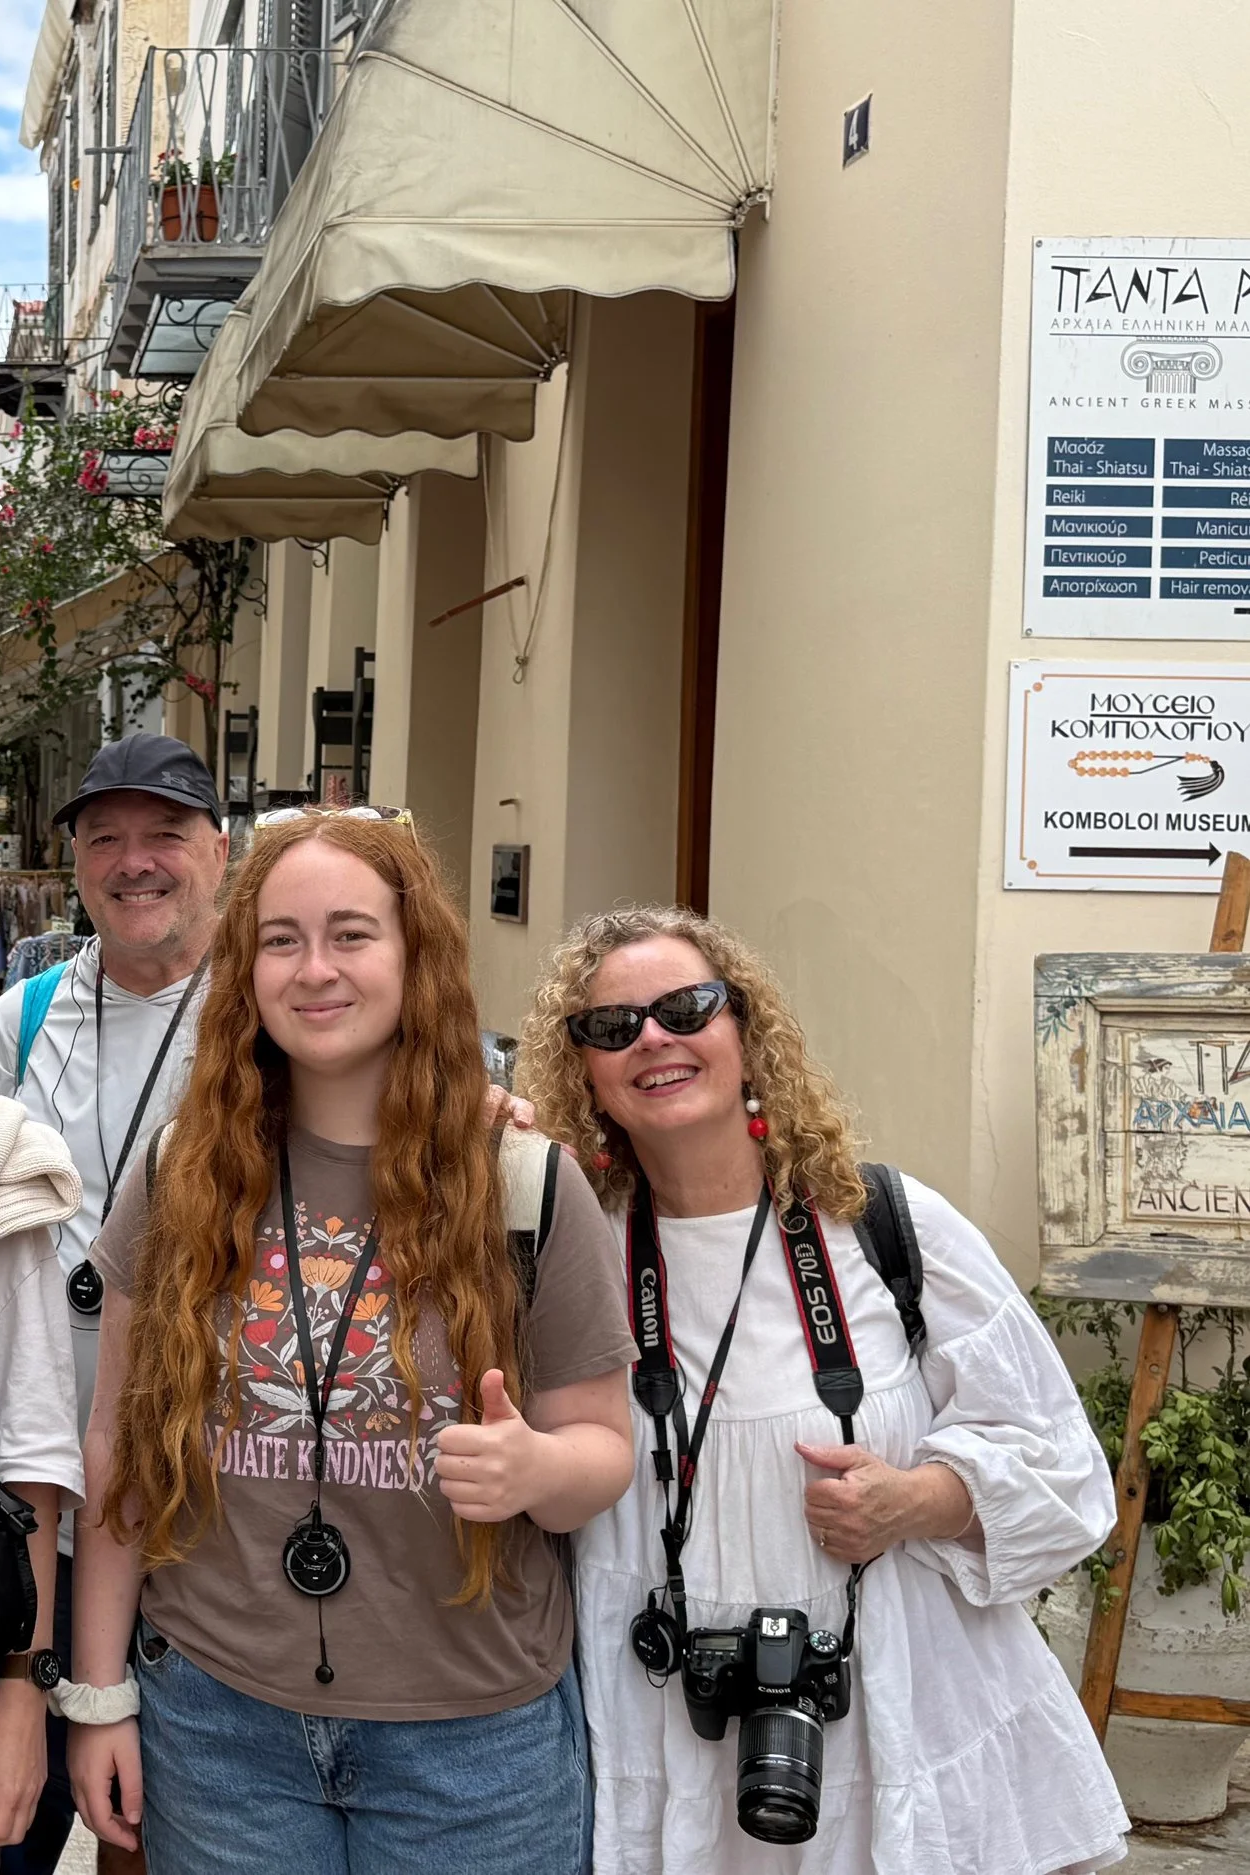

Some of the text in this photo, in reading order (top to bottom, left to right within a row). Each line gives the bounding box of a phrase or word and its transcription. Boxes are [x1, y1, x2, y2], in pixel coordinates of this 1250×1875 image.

[1050, 265, 1209, 314] ΠΑΝΤΑ
[1049, 396, 1129, 408] ANCIENT
[1140, 398, 1197, 409] GREEK
[1053, 460, 1083, 474] Thai
[1096, 460, 1147, 475] Shiatsu
[1170, 462, 1200, 475] Thai
[1053, 489, 1086, 503] Reiki
[1051, 519, 1128, 536] Μανικιούρ
[1196, 521, 1250, 535] Manicu
[1050, 548, 1127, 566] Πεντικιούρ
[1050, 578, 1138, 595] Αποτρίχωση
[1171, 580, 1250, 596] Hair remov
[1043, 811, 1159, 831] KOMBOLOI
[640, 1267, 659, 1348] Canon
[806, 1286, 837, 1345] EOS
[296, 1437, 427, 1492] KNDNESS
[757, 1685, 792, 1694] Canon
